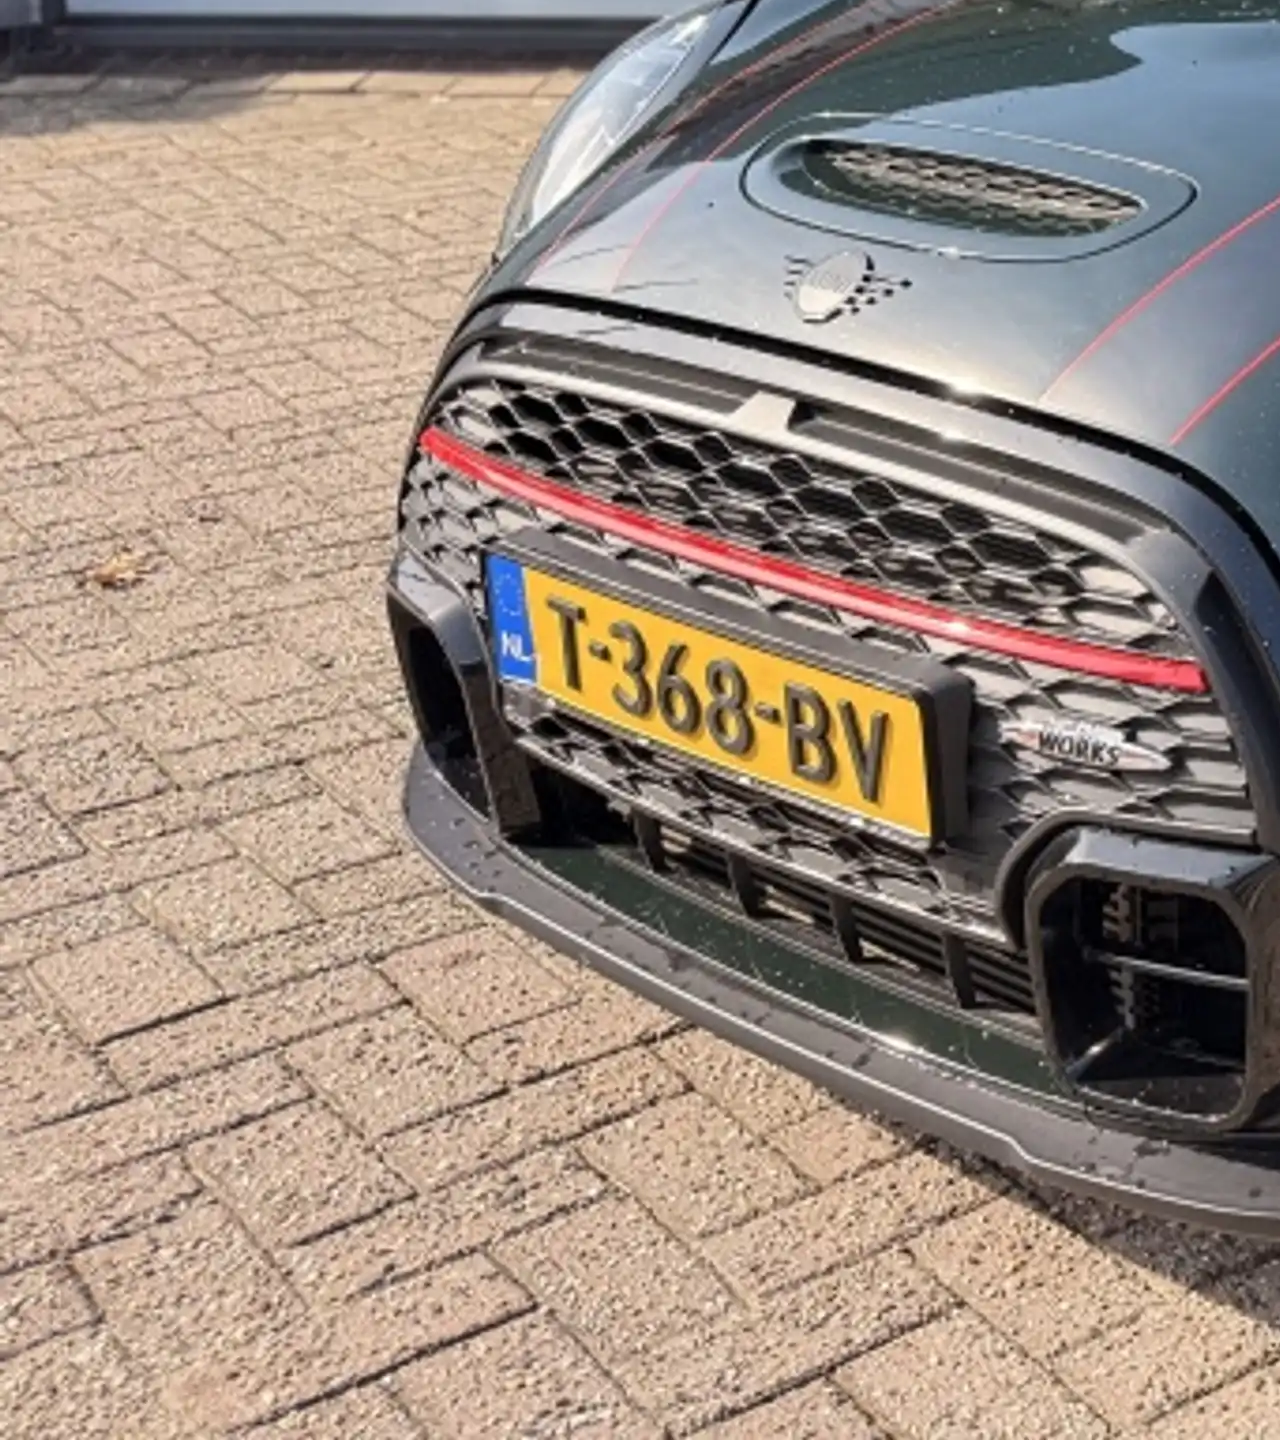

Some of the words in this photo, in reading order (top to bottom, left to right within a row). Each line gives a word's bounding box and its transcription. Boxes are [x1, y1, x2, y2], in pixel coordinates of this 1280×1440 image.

[501, 630, 539, 662] NL
[545, 593, 891, 804] T-368-BV
[1037, 731, 1123, 767] WORKS
